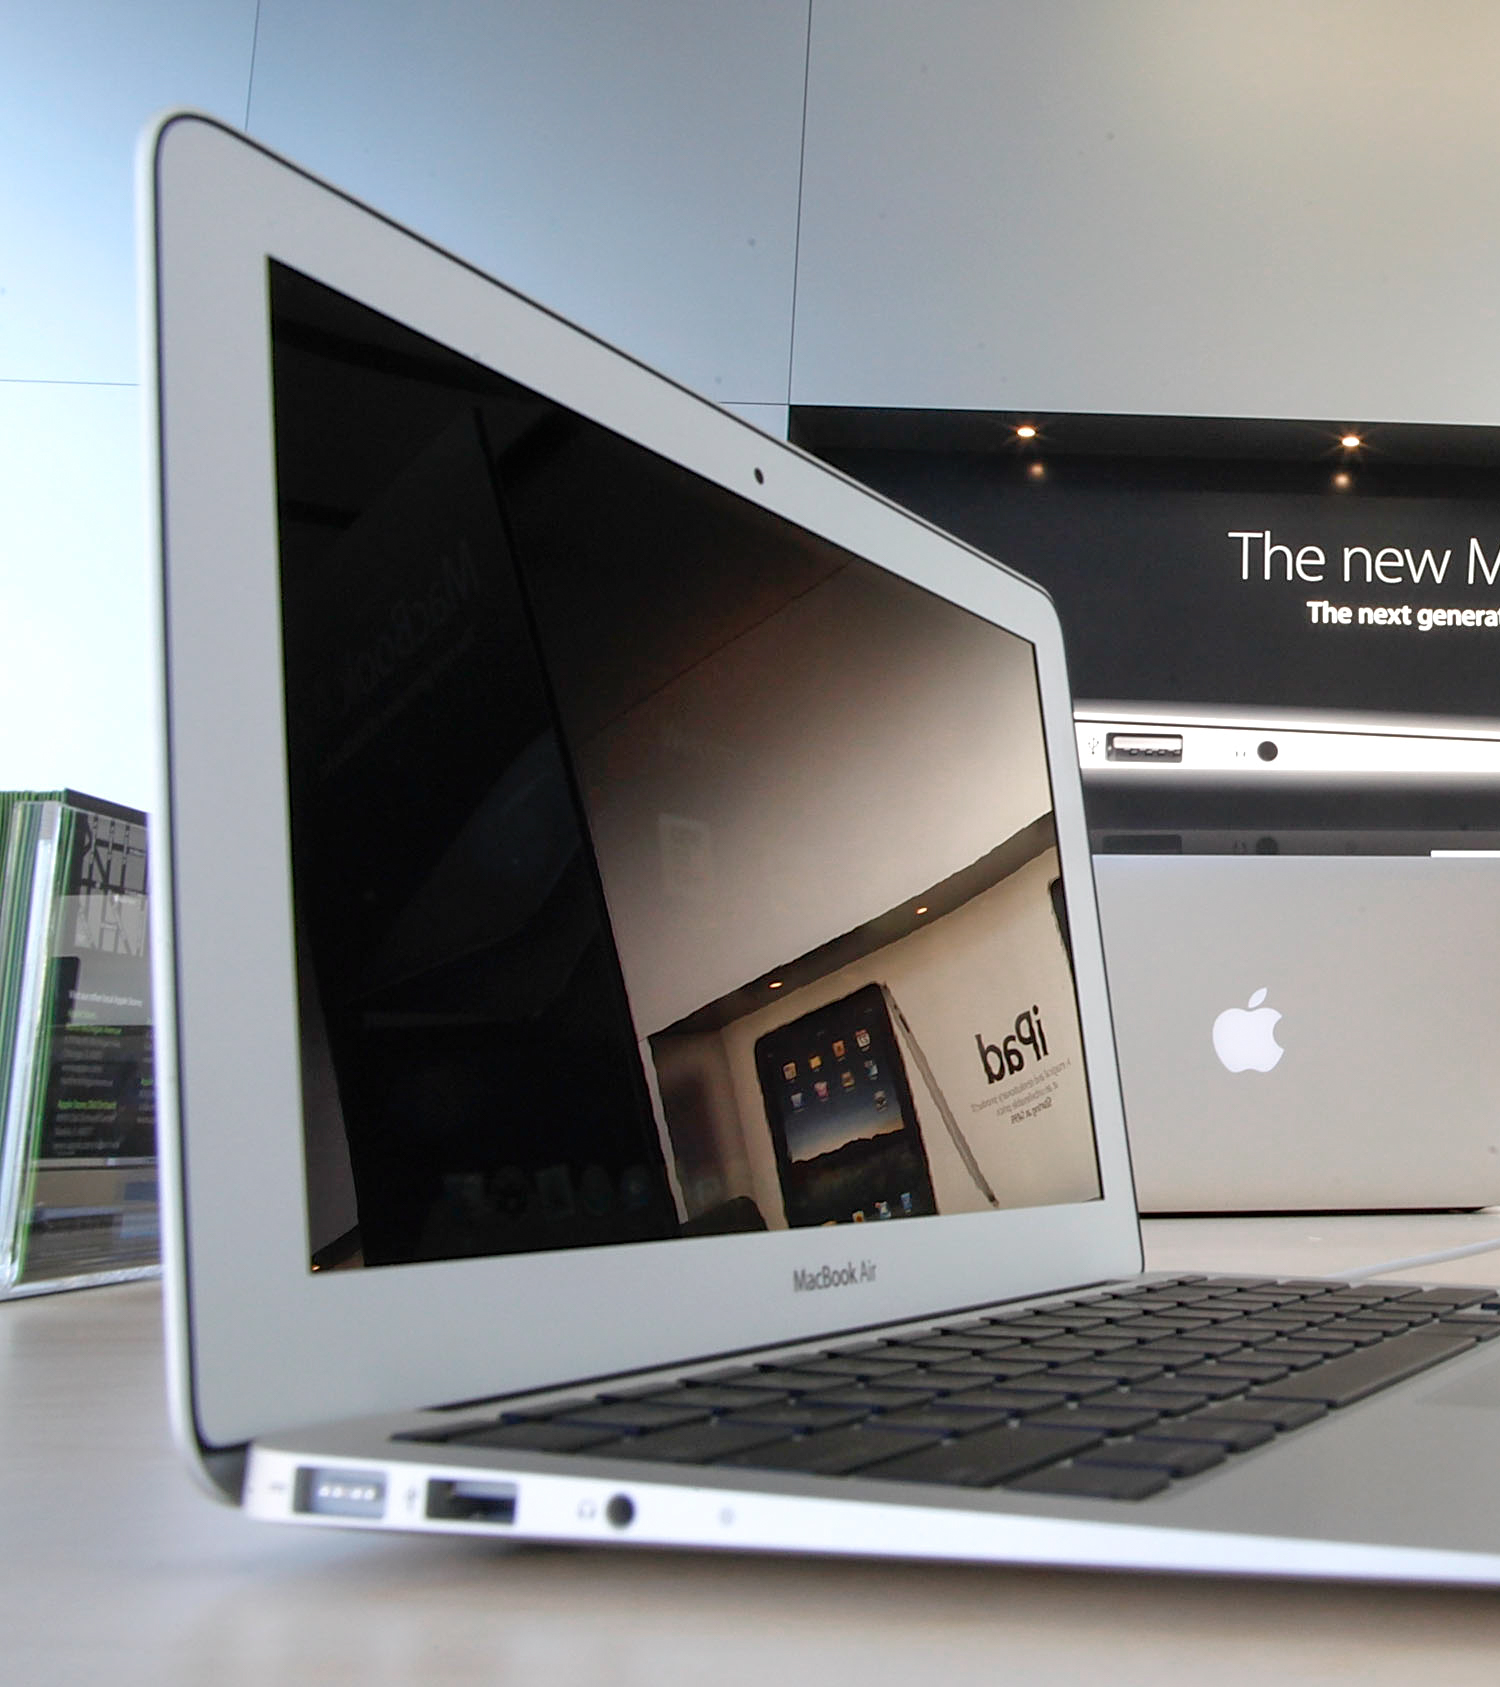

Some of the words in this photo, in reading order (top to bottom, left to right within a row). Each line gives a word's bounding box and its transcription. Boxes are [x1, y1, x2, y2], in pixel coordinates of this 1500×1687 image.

[1227, 530, 1327, 583] The
[1342, 546, 1453, 585] new
[1306, 600, 1353, 625] The
[1357, 604, 1412, 626] next
[793, 1261, 858, 1292] MacBook
[859, 1260, 877, 1282] Air
